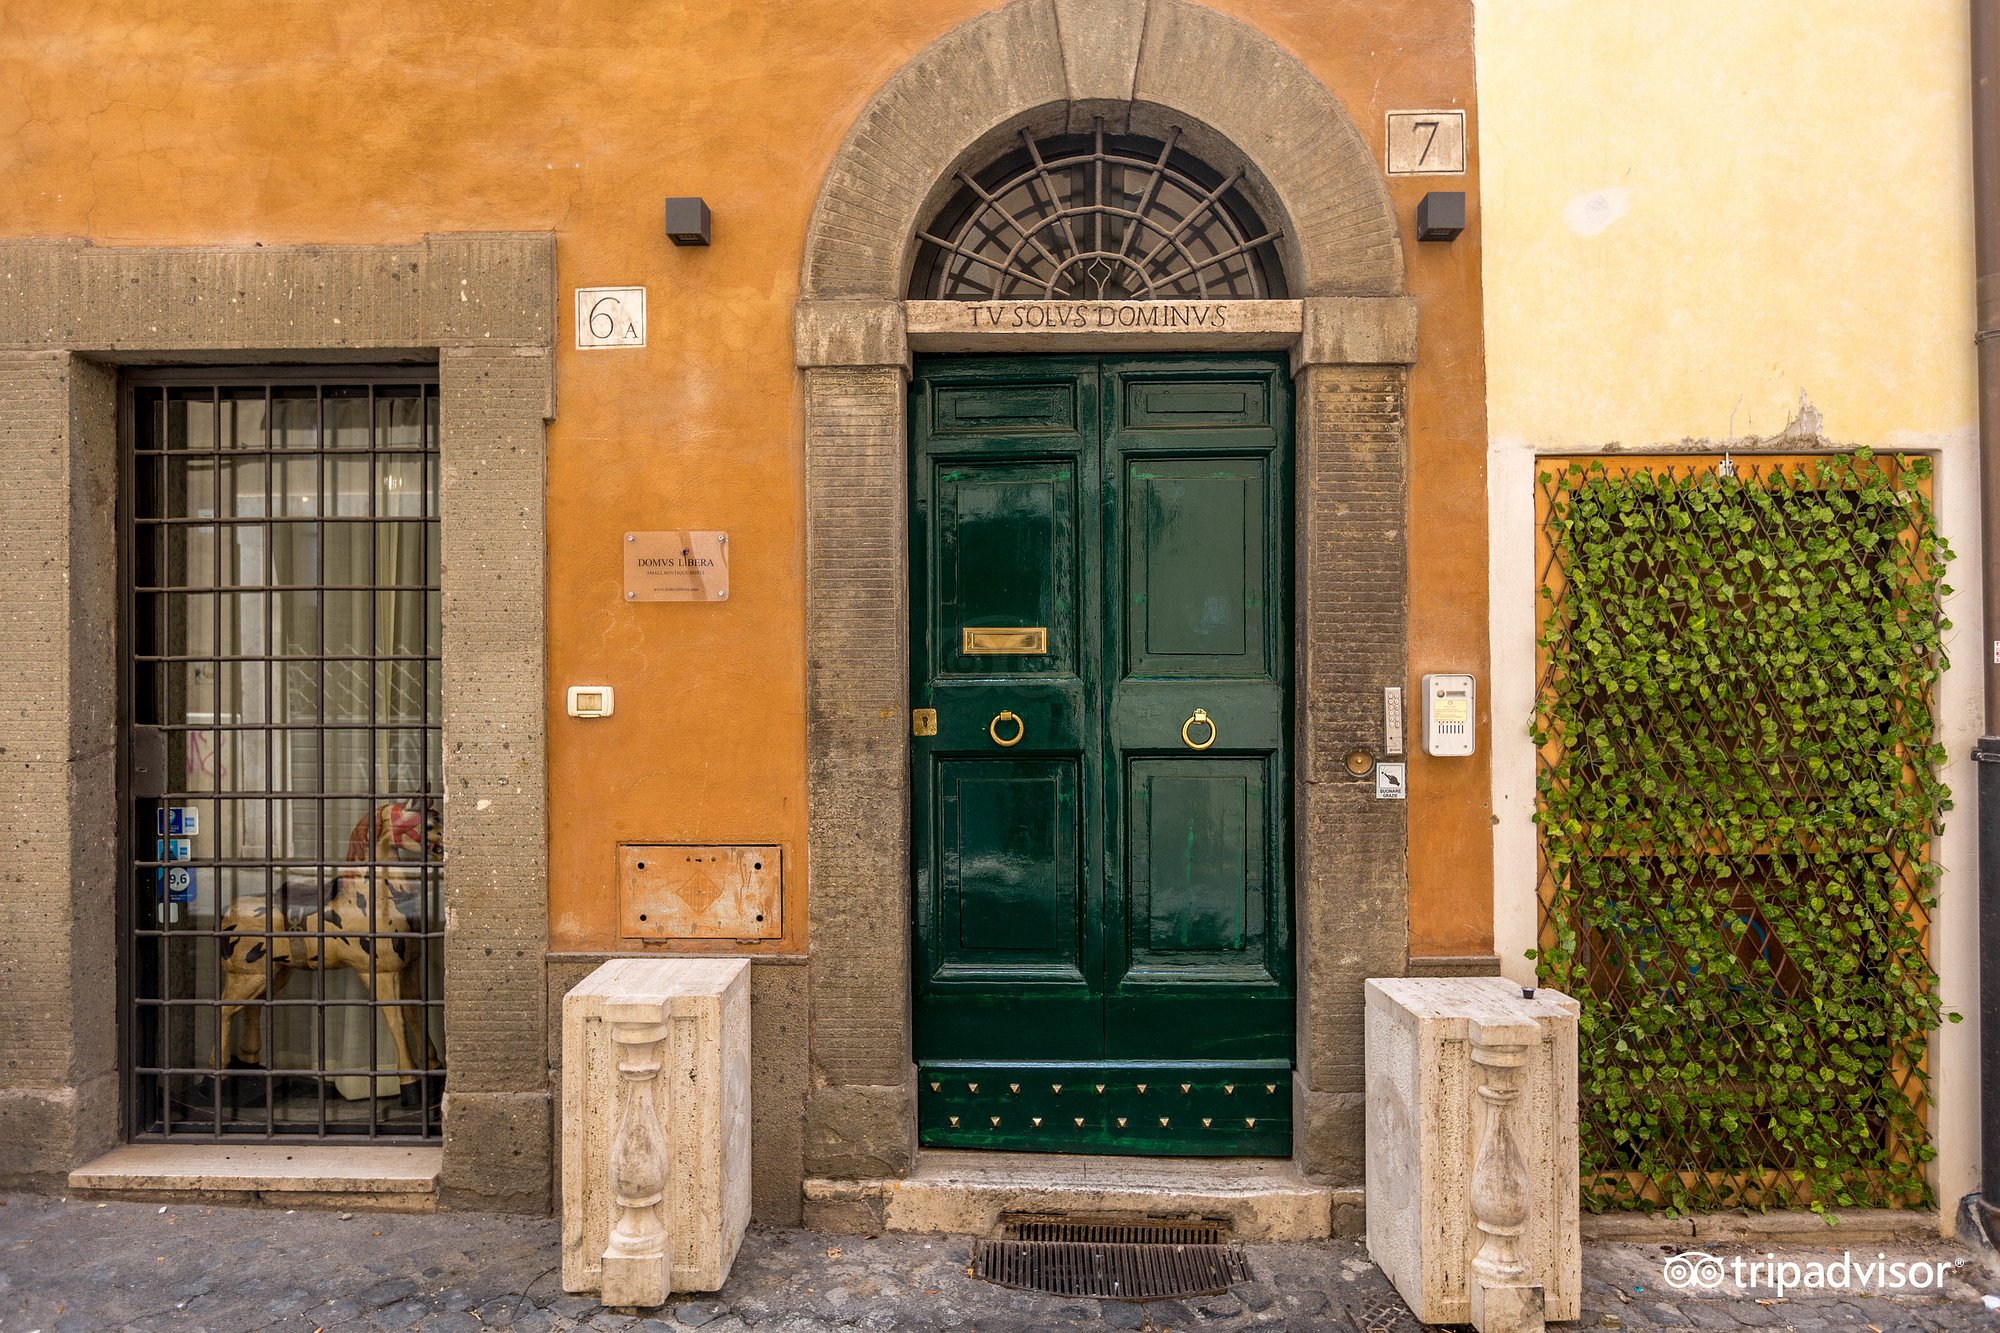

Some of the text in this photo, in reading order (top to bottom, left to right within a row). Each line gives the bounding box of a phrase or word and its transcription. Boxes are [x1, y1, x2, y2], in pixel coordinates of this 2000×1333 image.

[1411, 121, 1440, 166] 7
[968, 305, 1227, 328] TV SOLVS DOMINVS
[638, 558, 714, 567] DOMVS LIBERA
